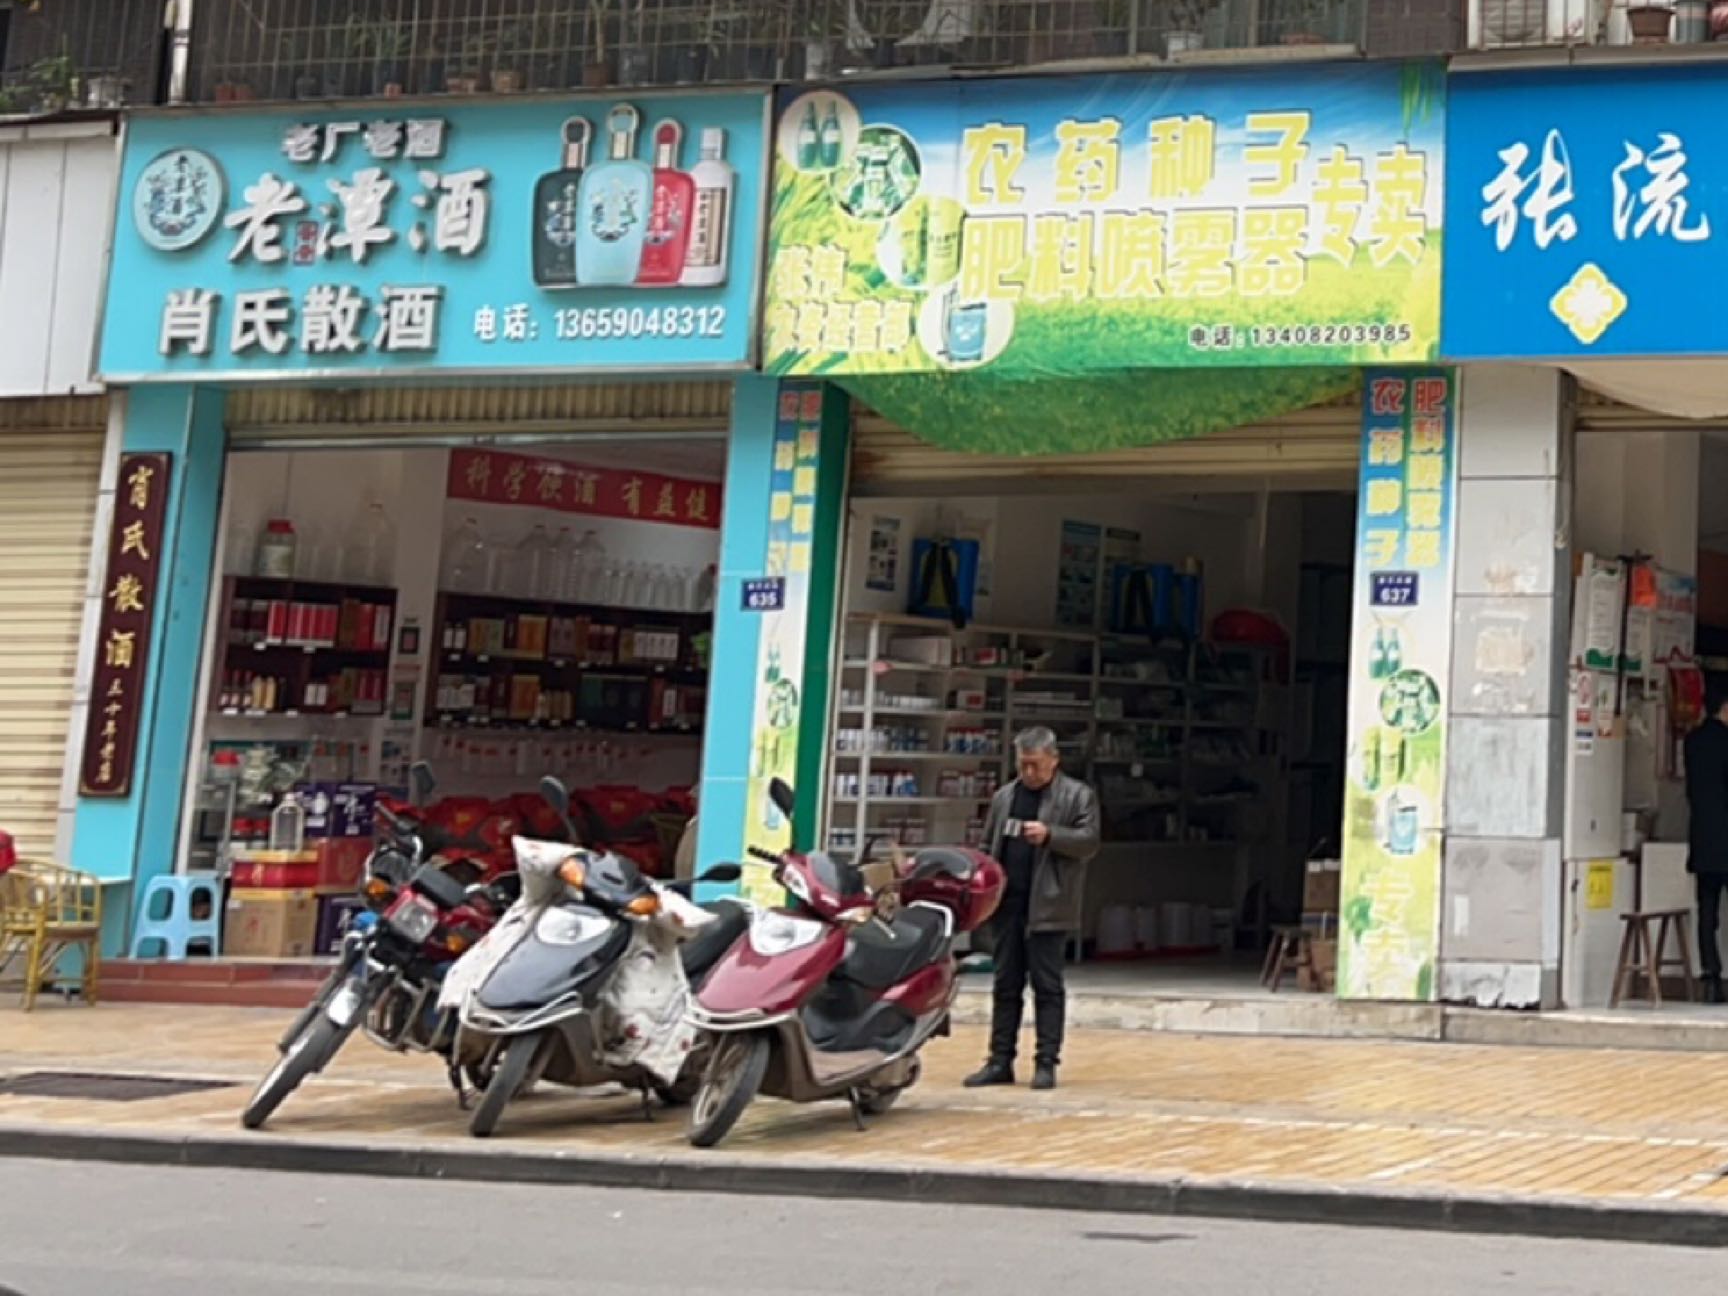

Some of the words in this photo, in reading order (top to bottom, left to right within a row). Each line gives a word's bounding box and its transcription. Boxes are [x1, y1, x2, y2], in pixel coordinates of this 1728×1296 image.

[281, 118, 445, 162] 老厂老酒
[963, 109, 1313, 206] 农药种子
[225, 166, 489, 263] 老潭酒
[1311, 144, 1430, 266] 专卖
[958, 206, 1309, 304] 肥料喷雾器
[159, 285, 442, 355] 肖氏散酒
